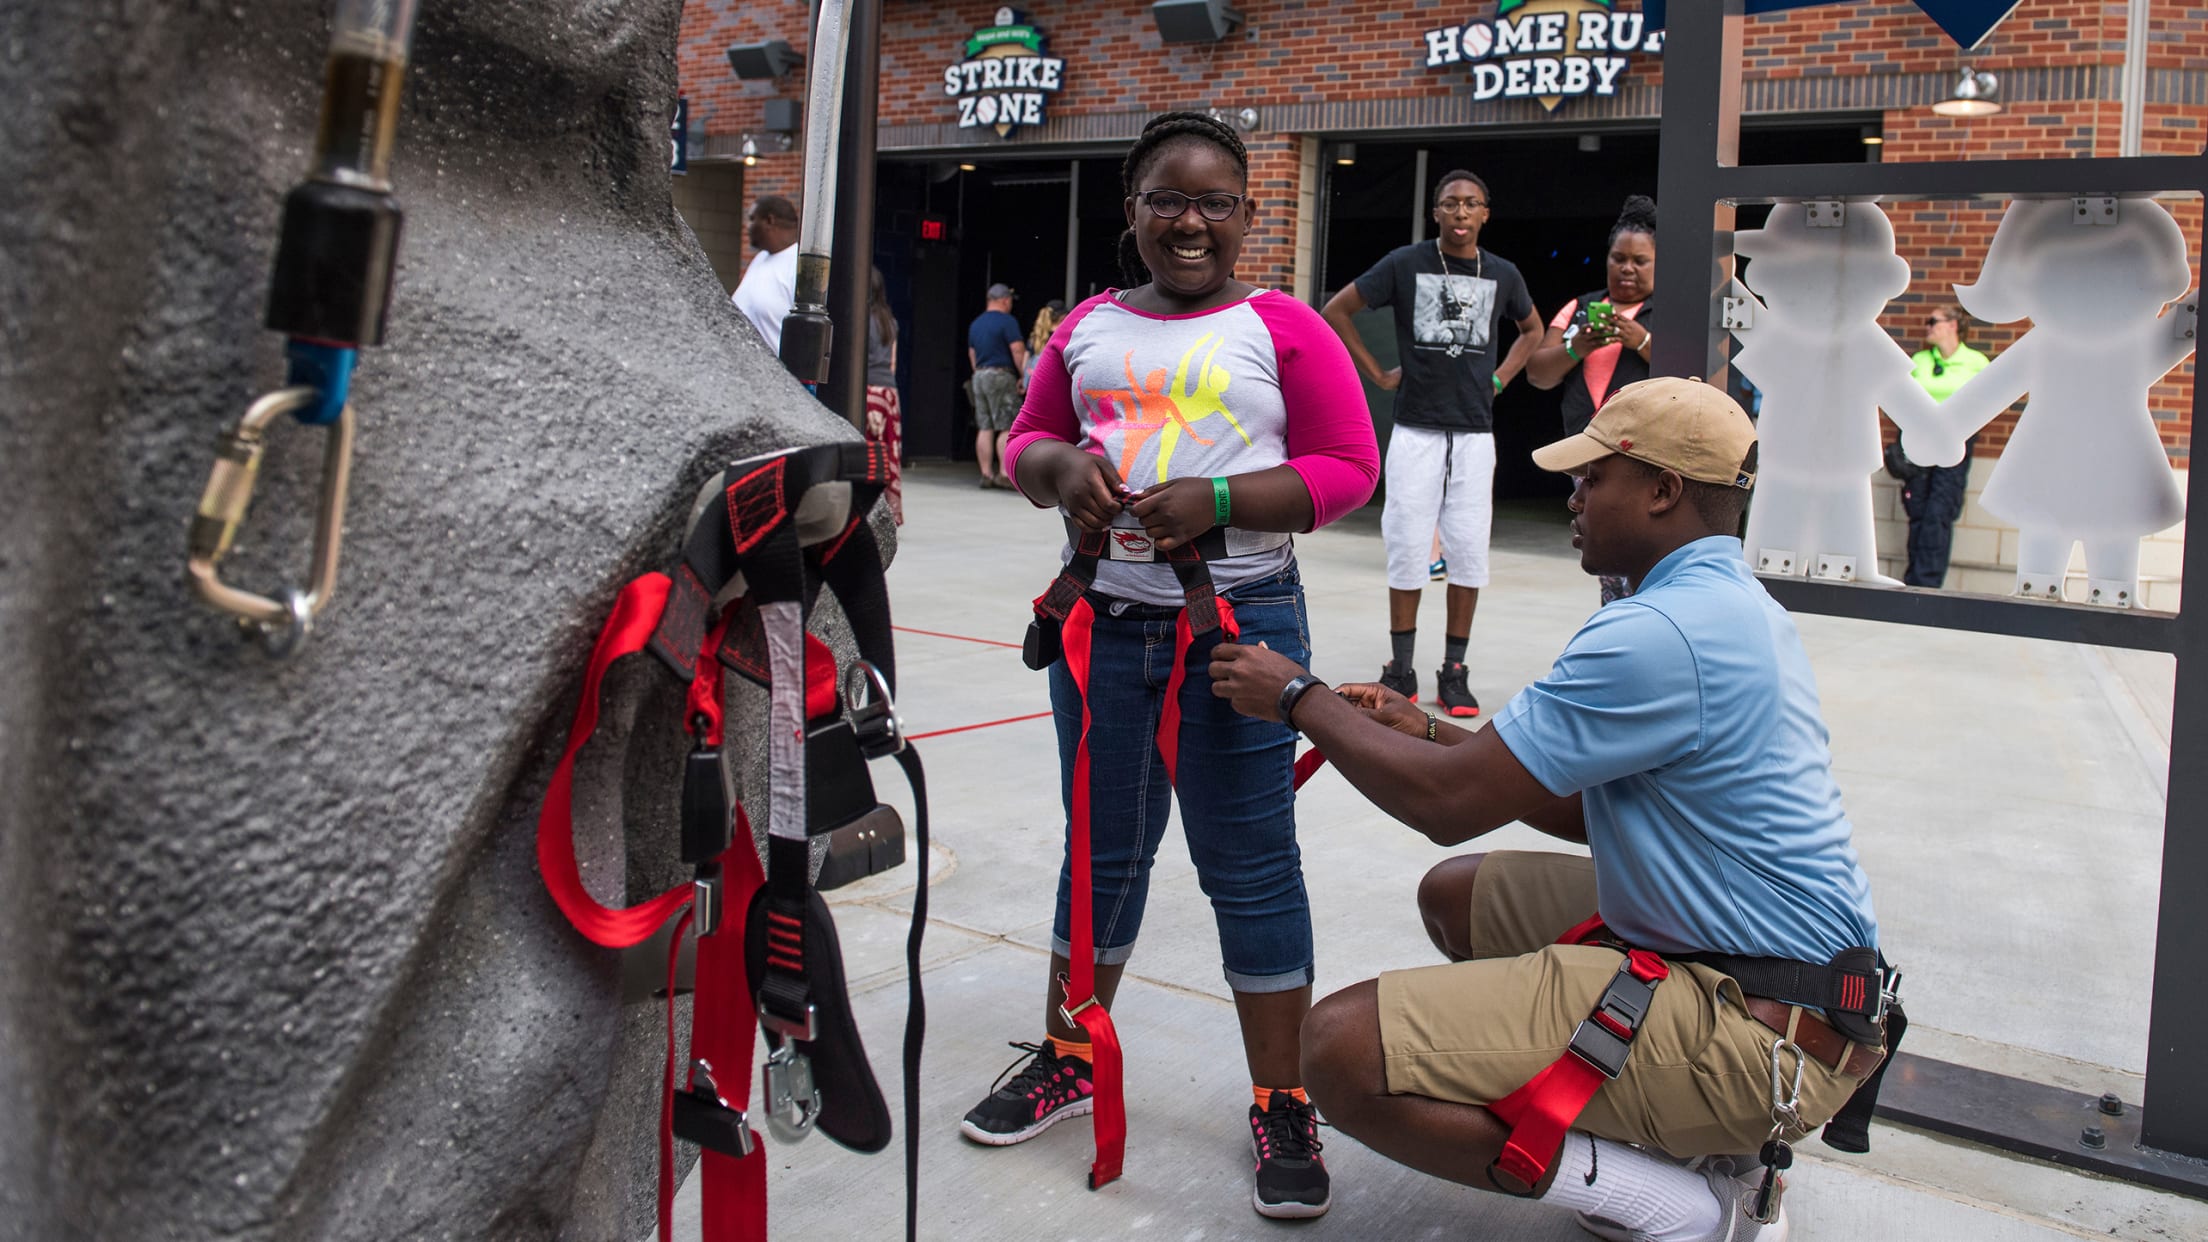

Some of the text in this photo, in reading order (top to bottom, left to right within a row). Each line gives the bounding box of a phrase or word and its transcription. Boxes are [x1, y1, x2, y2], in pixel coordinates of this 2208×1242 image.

[1425, 13, 1565, 66] HOME
[944, 57, 1062, 96] STRIKE
[1473, 57, 1626, 100] DERBY
[958, 93, 1043, 128] ZONE
[1219, 489, 1228, 512] EVENTS
